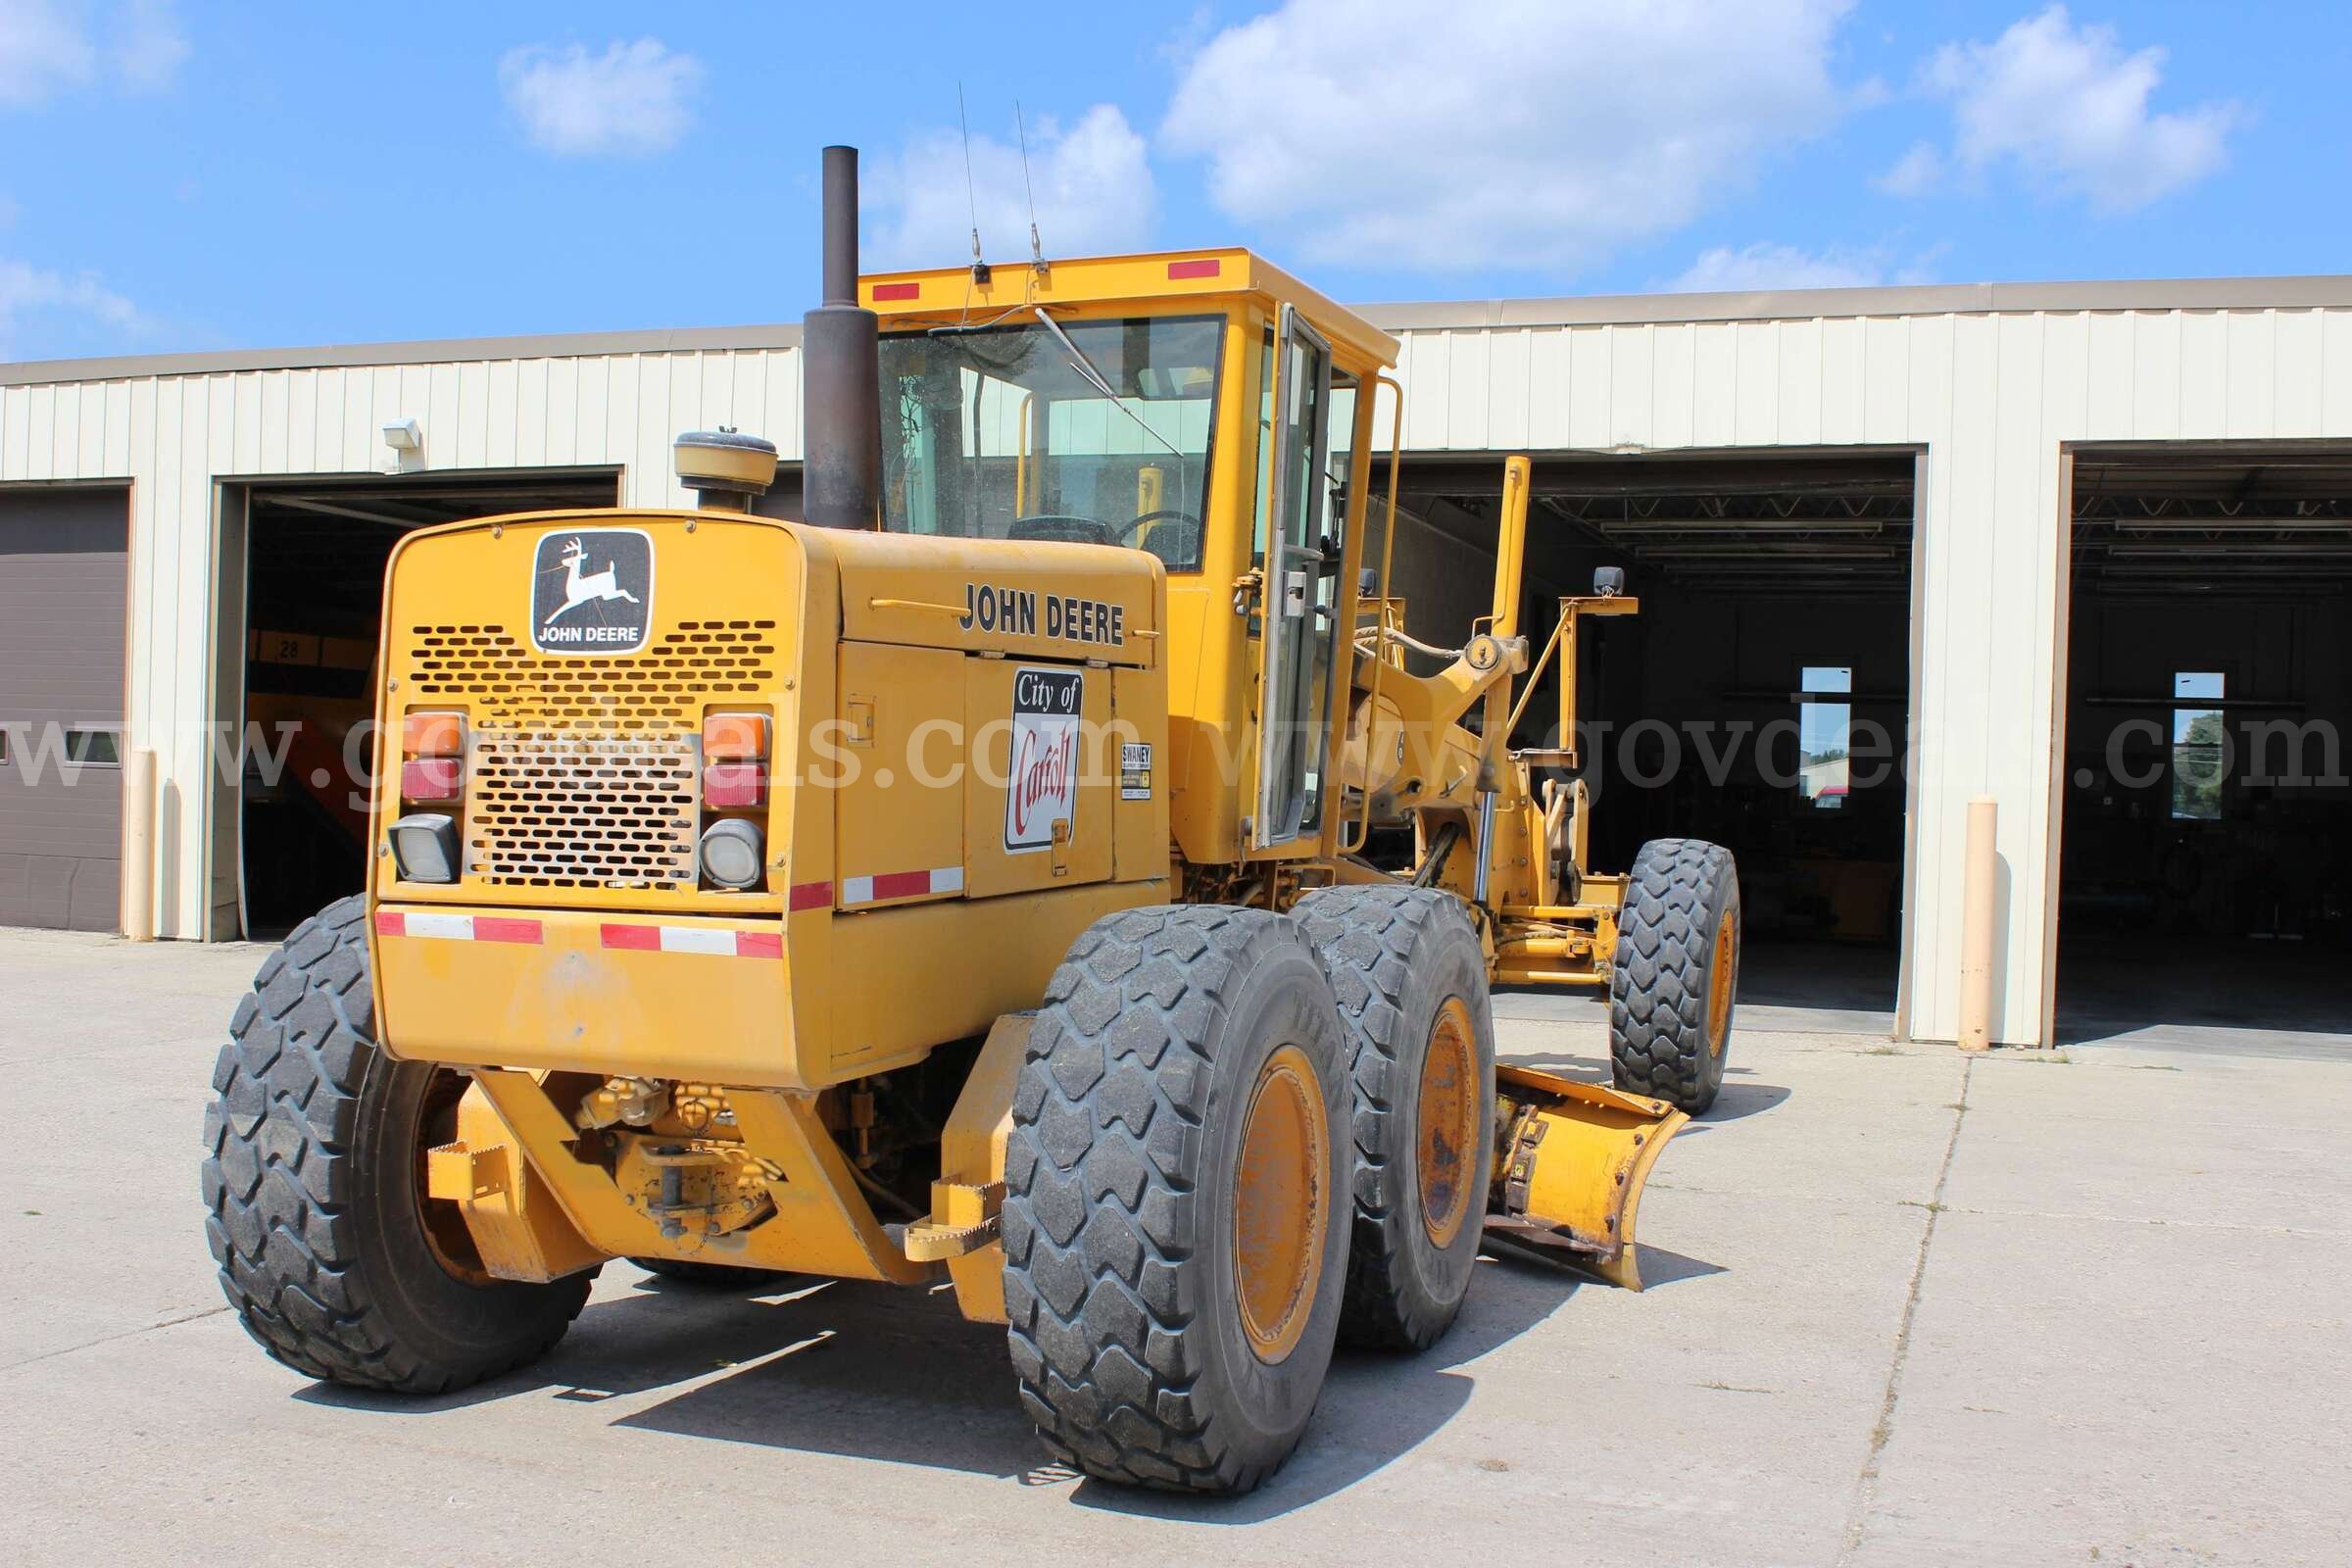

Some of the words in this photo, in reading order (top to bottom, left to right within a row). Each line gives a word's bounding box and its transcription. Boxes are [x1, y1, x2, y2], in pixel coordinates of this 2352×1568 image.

[957, 582, 1037, 637] JOHN
[1045, 594, 1125, 648] DEERE
[538, 626, 582, 642] JOHN
[585, 626, 639, 642] DEERE
[1017, 672, 1054, 713] City
[1060, 676, 1079, 713] of
[1122, 745, 1150, 763] SWANEY
